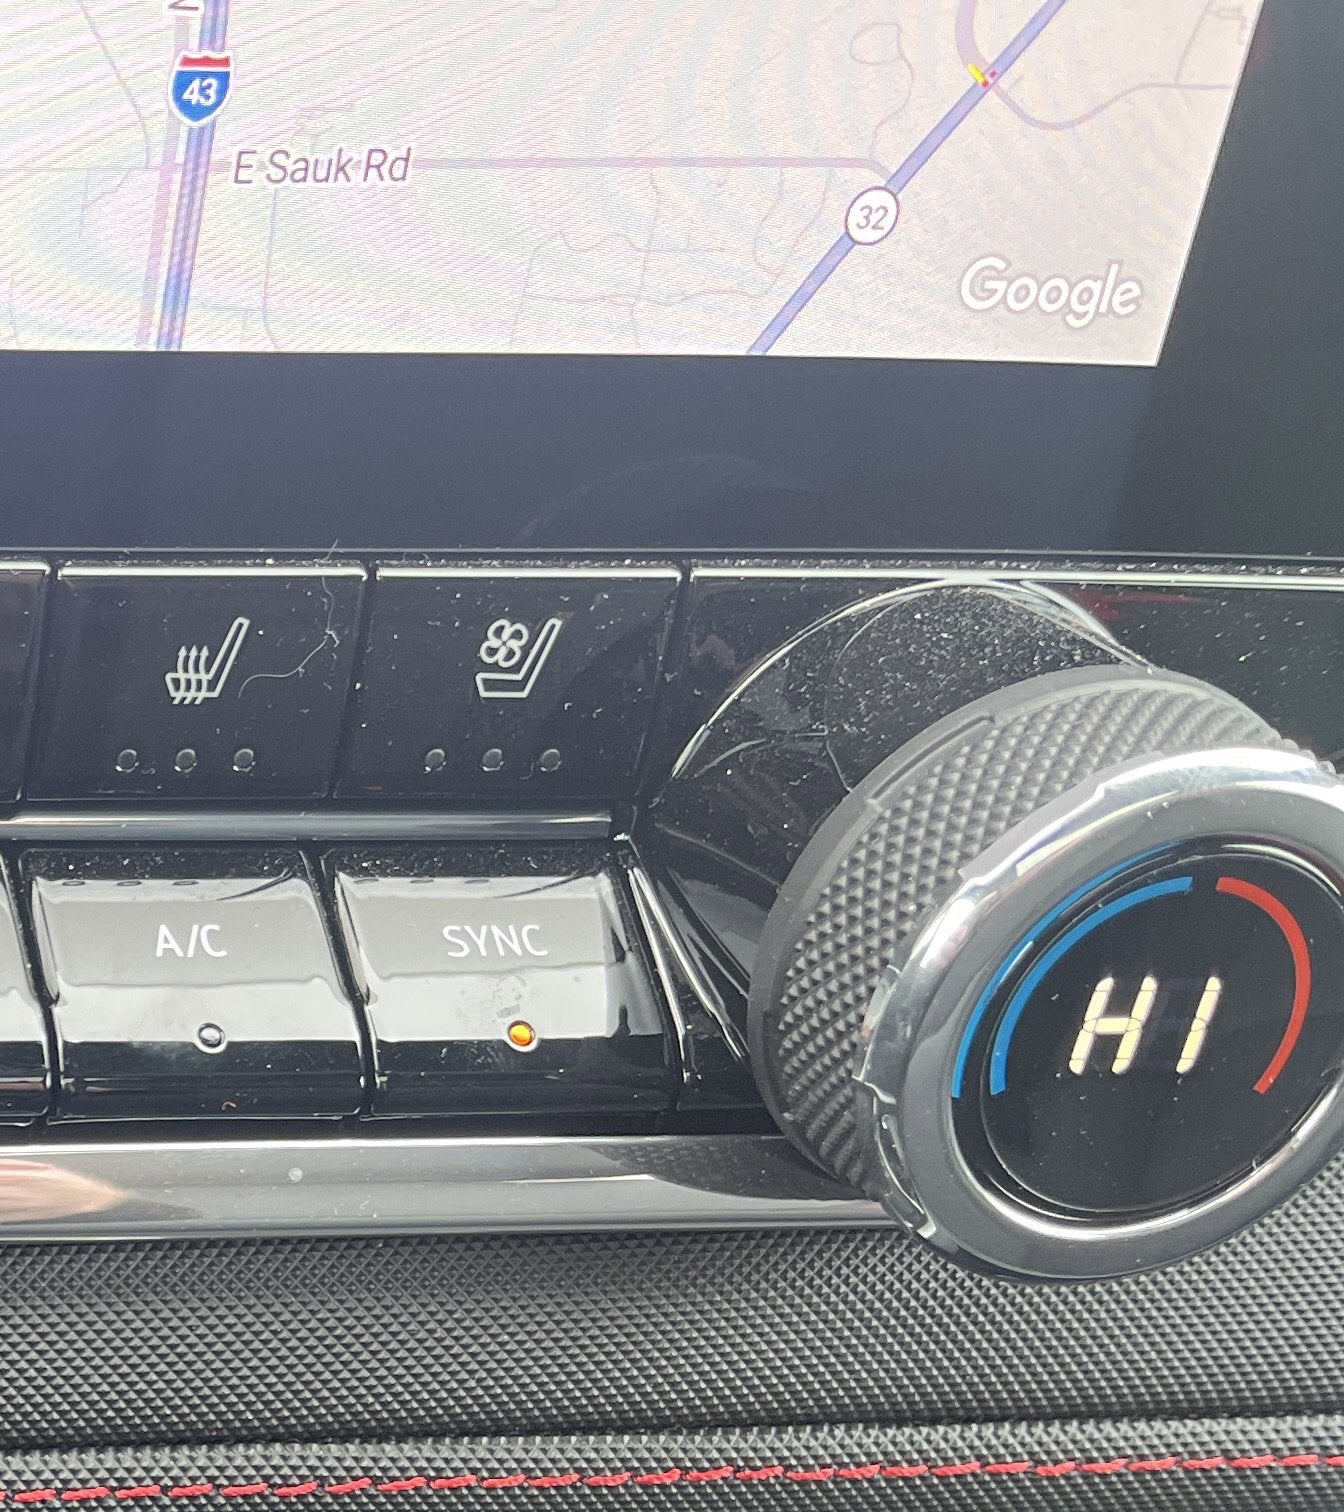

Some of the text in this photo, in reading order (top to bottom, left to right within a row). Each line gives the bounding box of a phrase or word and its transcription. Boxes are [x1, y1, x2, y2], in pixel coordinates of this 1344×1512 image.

[181, 77, 220, 107] 43
[232, 146, 413, 185] E Sauk Rd
[854, 204, 890, 232] 32
[959, 255, 1143, 329] Google
[154, 924, 229, 961] A/C
[441, 922, 550, 961] SYNC
[1067, 974, 1225, 1077] HI
